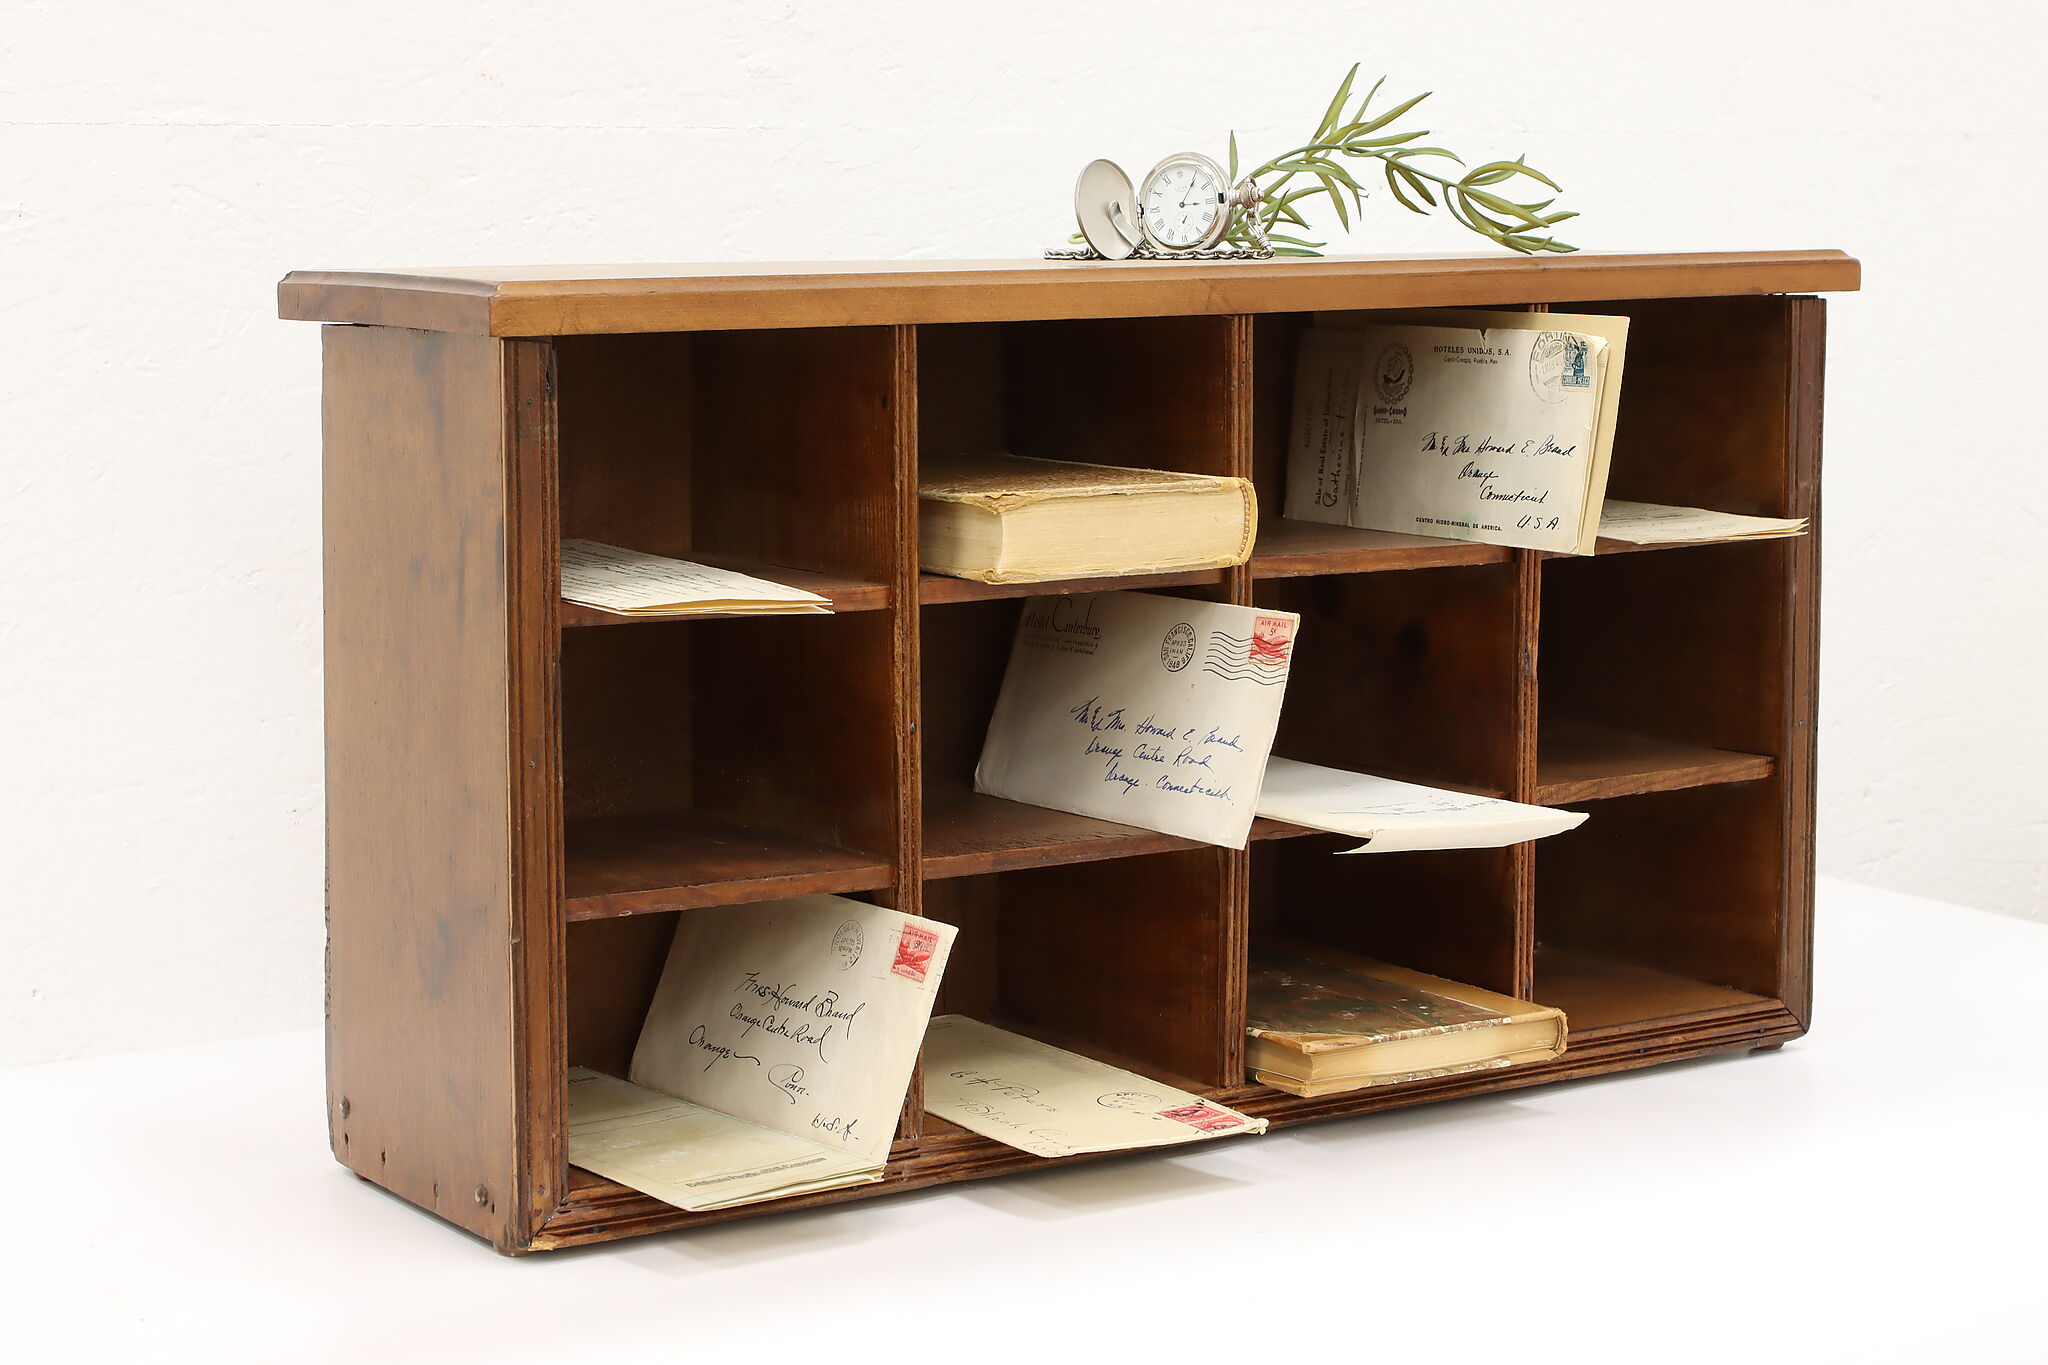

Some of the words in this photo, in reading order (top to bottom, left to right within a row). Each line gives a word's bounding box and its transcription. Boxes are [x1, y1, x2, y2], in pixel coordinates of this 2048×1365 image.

[1433, 345, 1464, 354] HOTELES
[1322, 418, 1329, 427] of
[1320, 430, 1329, 454] Estate
[1474, 435, 1515, 455] Howard
[1533, 434, 1577, 458] Brand
[1318, 455, 1326, 474] Real
[1457, 461, 1498, 487] Orange
[1317, 477, 1323, 485] of
[1314, 489, 1323, 505] Sale
[1415, 516, 1434, 524] CENTRO
[1272, 621, 1287, 629] MAIL
[1135, 714, 1176, 740] Howard
[1085, 736, 1123, 767] Orange
[1133, 743, 1166, 763] Centre
[1172, 746, 1215, 774] Road
[762, 983, 818, 1011] Howard
[815, 990, 866, 1040] Brand
[729, 1003, 761, 1038] Orange
[790, 1023, 833, 1064] Road
[689, 1024, 738, 1073] Orange
